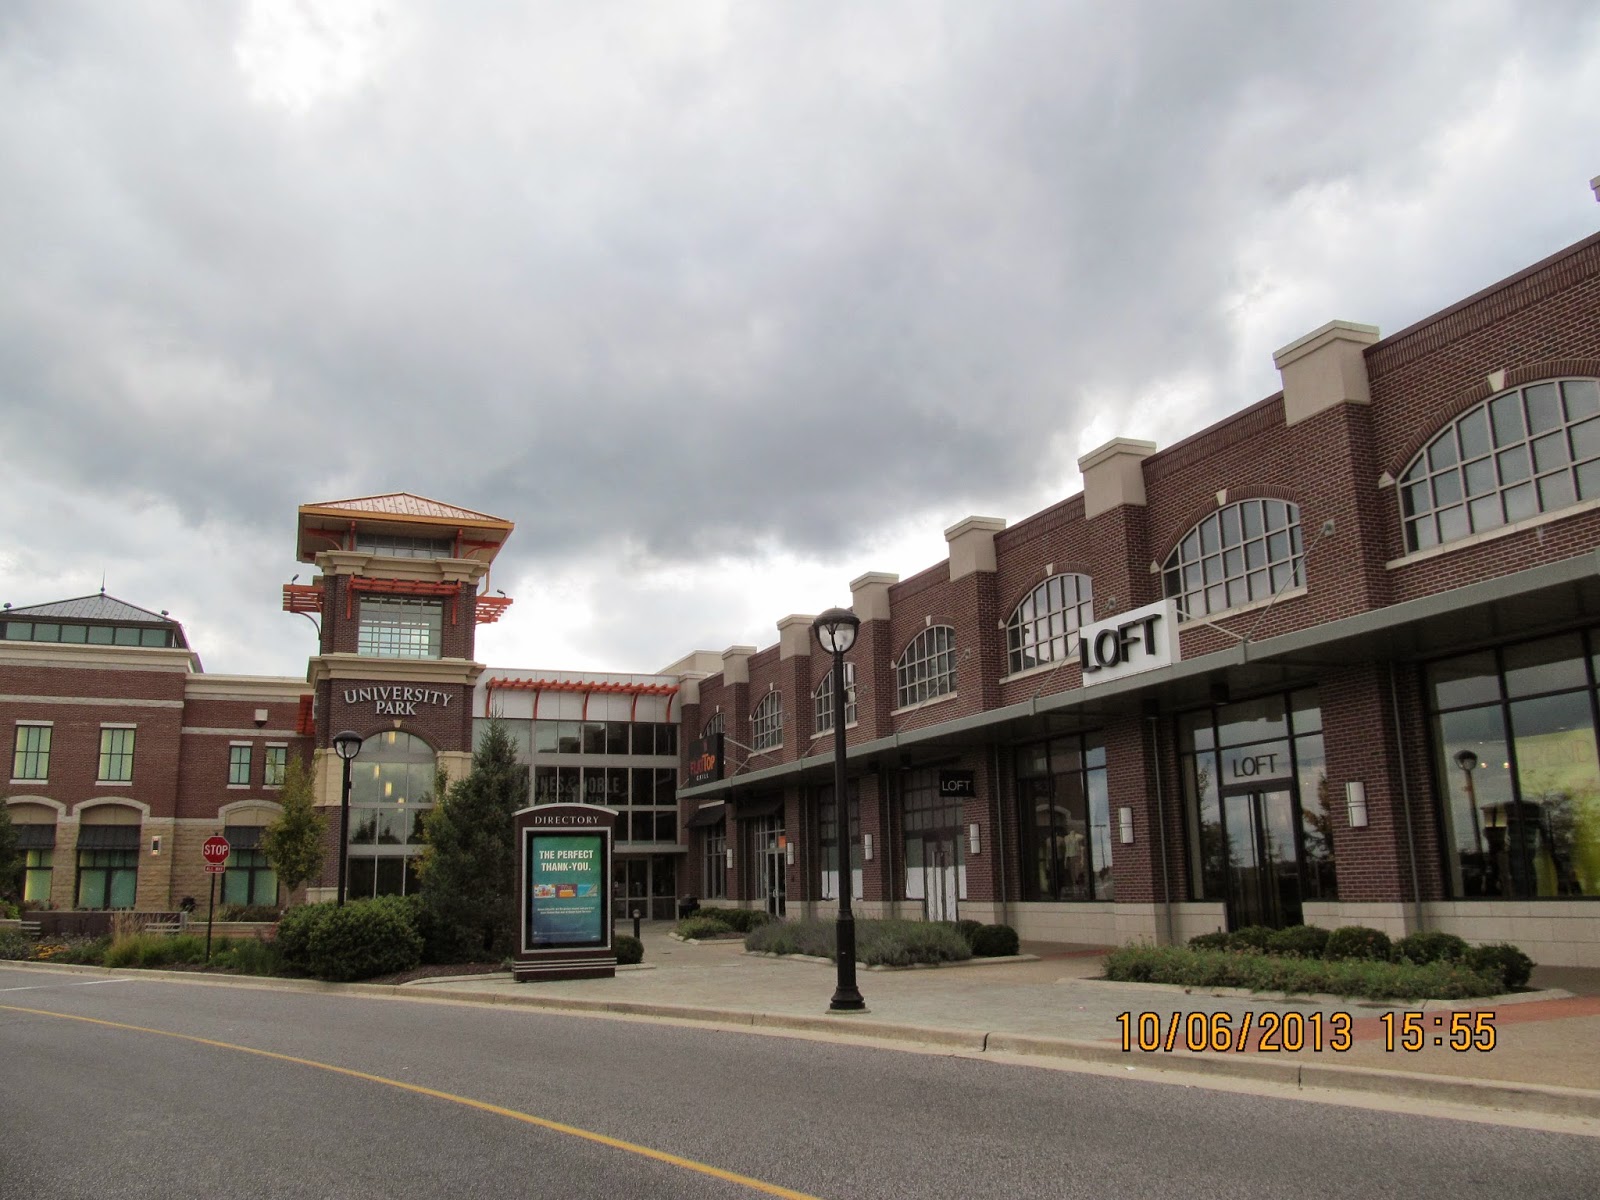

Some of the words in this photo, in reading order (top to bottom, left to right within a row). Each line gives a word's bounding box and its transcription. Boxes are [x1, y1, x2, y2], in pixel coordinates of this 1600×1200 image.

[1079, 613, 1162, 673] LOFT
[343, 686, 454, 707] UNIVERSITY
[375, 701, 417, 715] PARK
[1233, 753, 1278, 777] LOFT
[942, 780, 971, 791] LOFT
[534, 815, 600, 825] DIRECTORY
[204, 844, 228, 855] STOP
[539, 850, 555, 859] THE
[557, 849, 594, 859] PERFECT
[541, 862, 592, 871] THANK-YOU.
